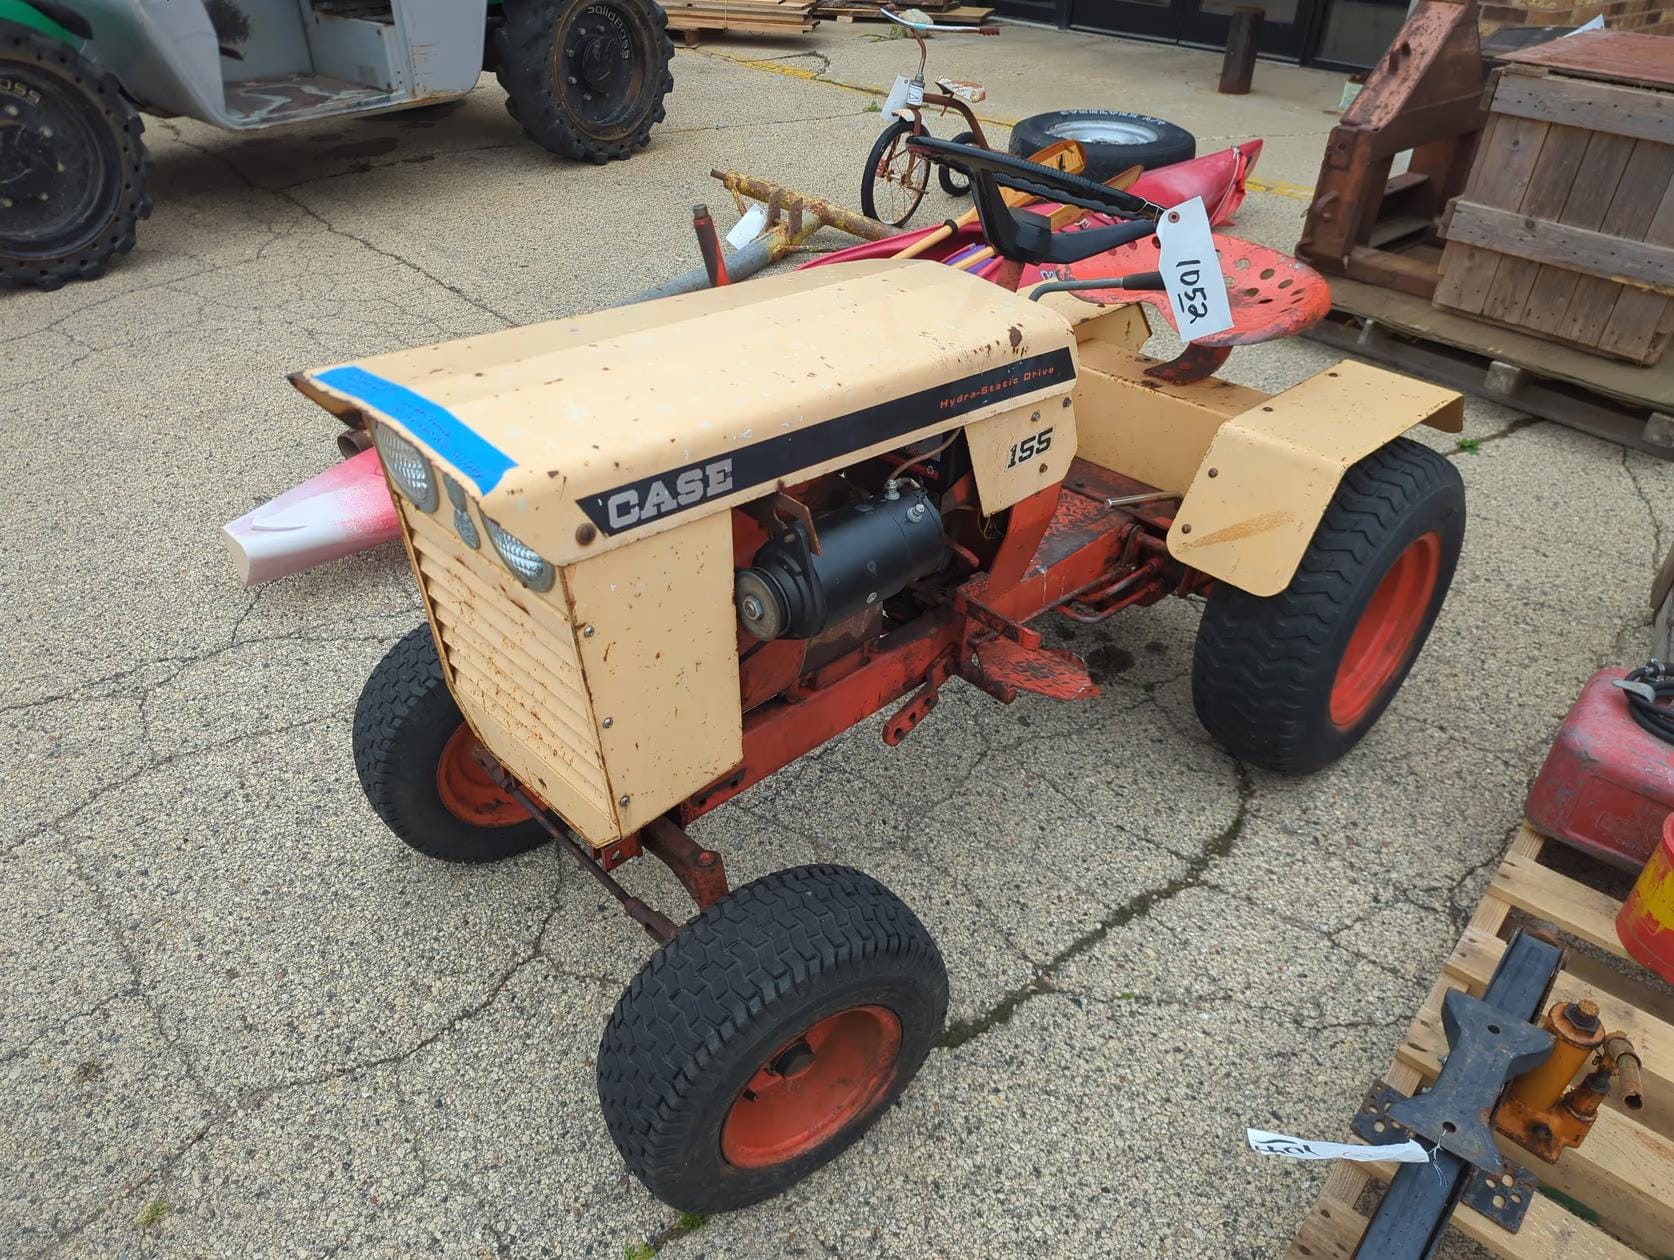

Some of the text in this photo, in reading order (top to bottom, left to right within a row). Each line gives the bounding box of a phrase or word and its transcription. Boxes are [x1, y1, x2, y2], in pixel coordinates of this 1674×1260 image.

[1176, 259, 1208, 324] 1052
[940, 366, 1056, 409] Hydra-Static Drive
[1007, 427, 1054, 469] 155
[607, 458, 733, 529] CASE
